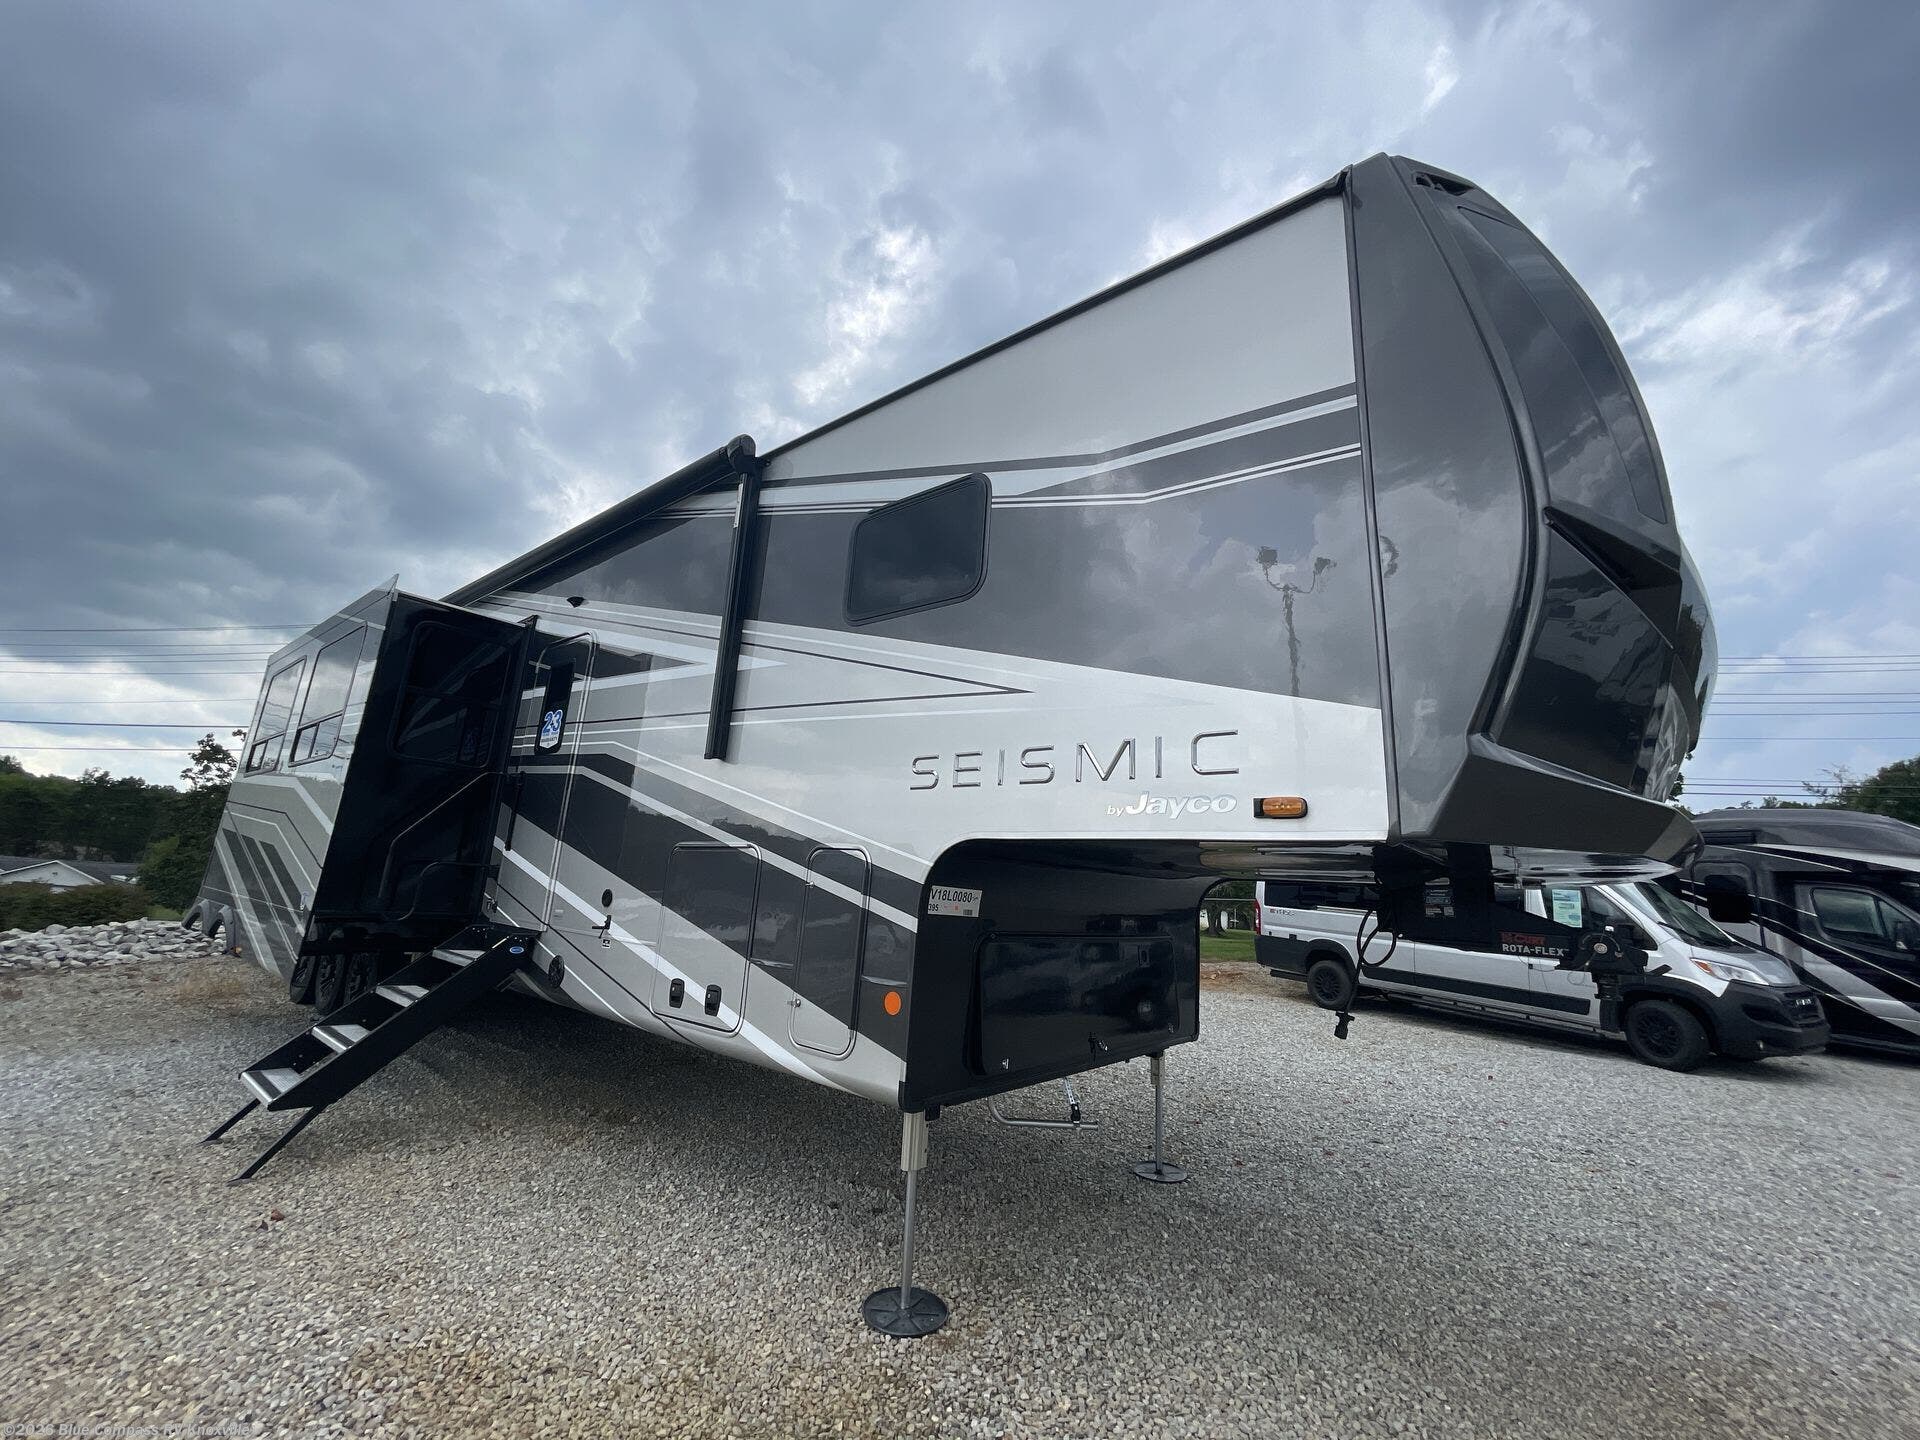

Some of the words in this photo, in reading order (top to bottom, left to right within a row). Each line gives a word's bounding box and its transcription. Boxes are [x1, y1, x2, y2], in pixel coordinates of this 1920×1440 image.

[910, 730, 1239, 789] SEISMIC
[1106, 805, 1126, 817] by
[1126, 790, 1238, 820] Jayco
[1502, 943, 1565, 957] ROTA-FLEX
